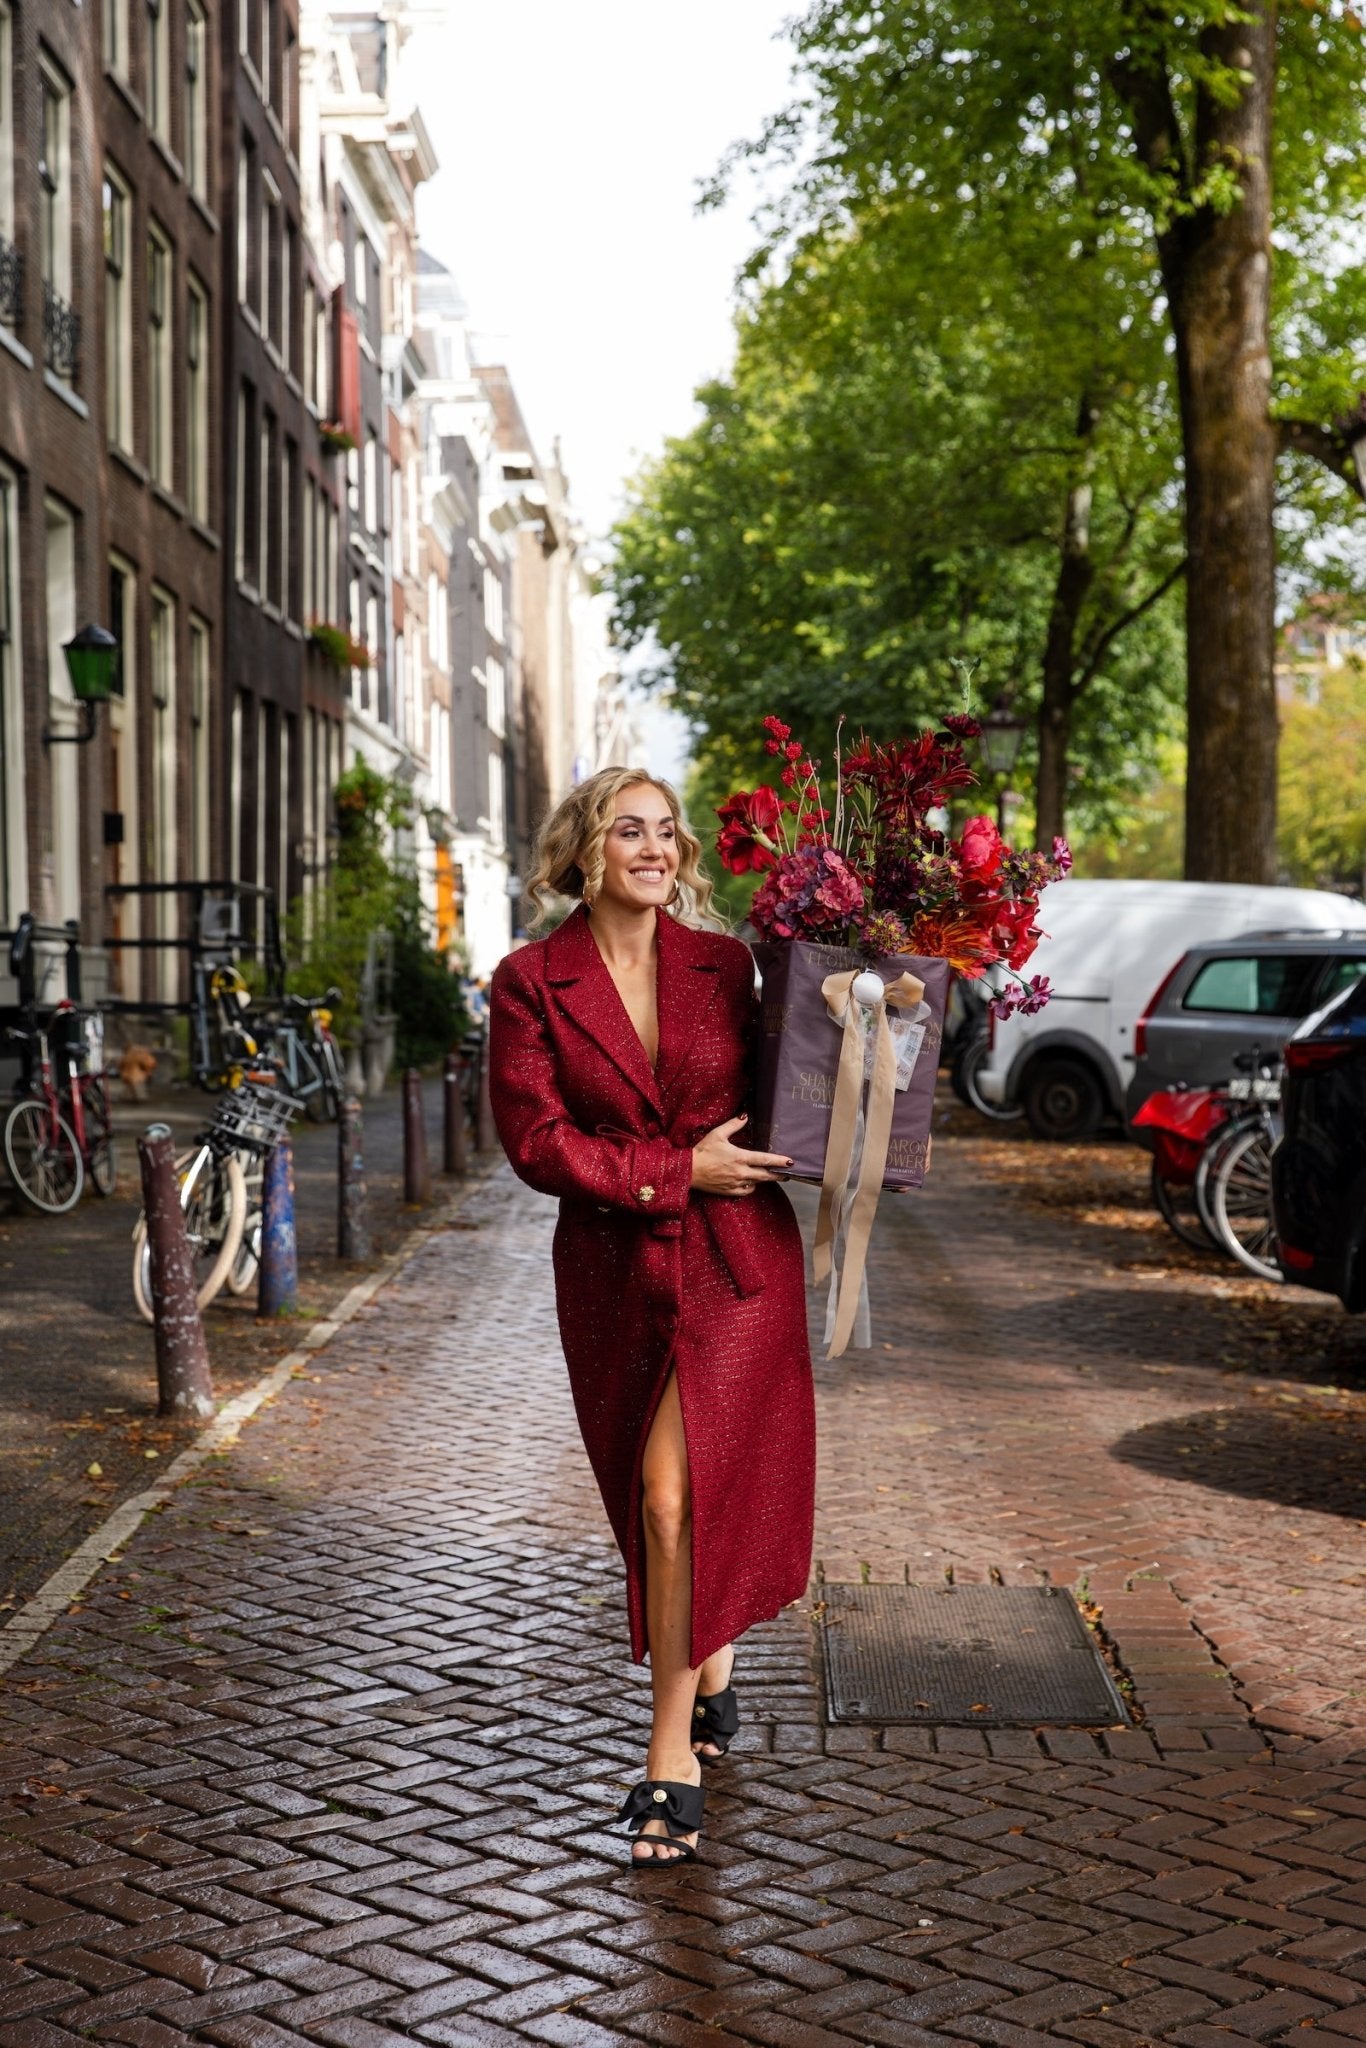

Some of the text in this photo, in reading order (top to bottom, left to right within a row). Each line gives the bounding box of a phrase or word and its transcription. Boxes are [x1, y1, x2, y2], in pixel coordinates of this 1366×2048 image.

[799, 1072, 836, 1089] SHAR
[791, 1085, 834, 1104] FLOW
[889, 1138, 927, 1155] ARON
[886, 1152, 924, 1170] OWER
